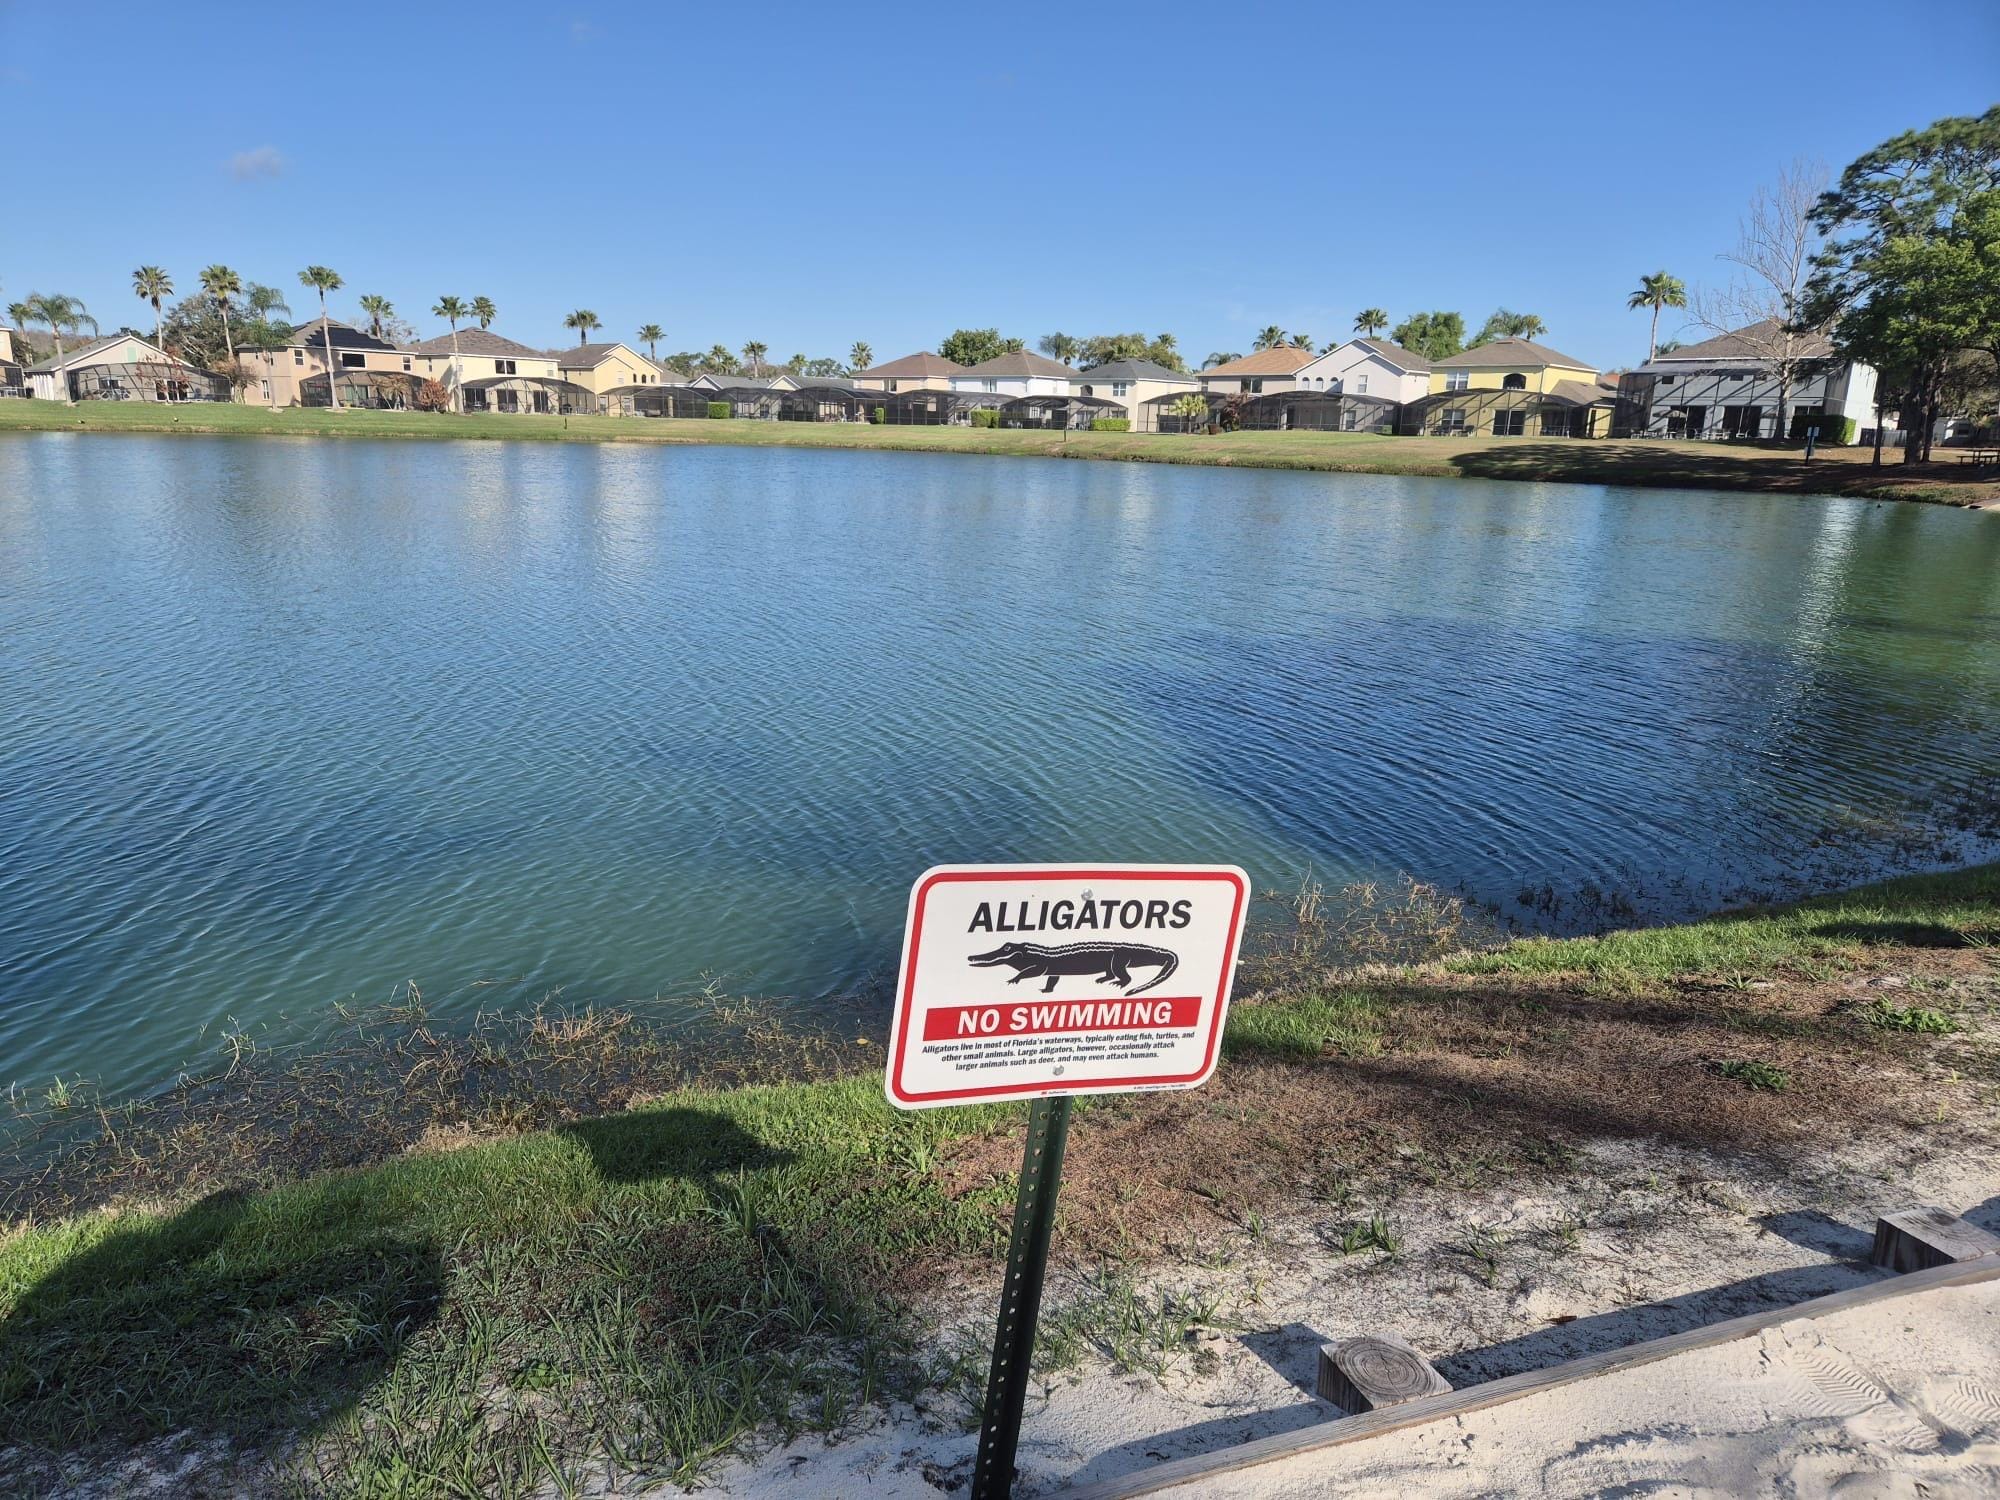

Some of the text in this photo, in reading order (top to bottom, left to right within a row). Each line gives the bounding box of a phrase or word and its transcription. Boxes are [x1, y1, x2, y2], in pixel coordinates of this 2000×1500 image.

[968, 899, 1193, 933] ALLIGATORS
[957, 1001, 1173, 1035] NO SWIMMING
[922, 1043, 959, 1054] Alligators
[960, 1042, 973, 1051] live
[983, 1040, 1001, 1049] most
[1003, 1040, 1011, 1048] of
[1012, 1037, 1043, 1047] Florida's
[1044, 1036, 1083, 1044] waterways,
[1085, 1034, 1115, 1043] typically
[1115, 1033, 1138, 1041] eating
[1139, 1032, 1154, 1040] fish,
[941, 1041, 1175, 1062] other small animals. Large alligators, however, occasionally attack
[955, 1062, 978, 1072] larger
[979, 1060, 1009, 1069] animals
[1009, 1058, 1027, 1066] such
[1057, 1055, 1071, 1063] and
[1072, 1054, 1088, 1062] may
[1088, 1053, 1105, 1061] even
[1106, 1052, 1129, 1060] attack
[1130, 1051, 1160, 1059] humans.
